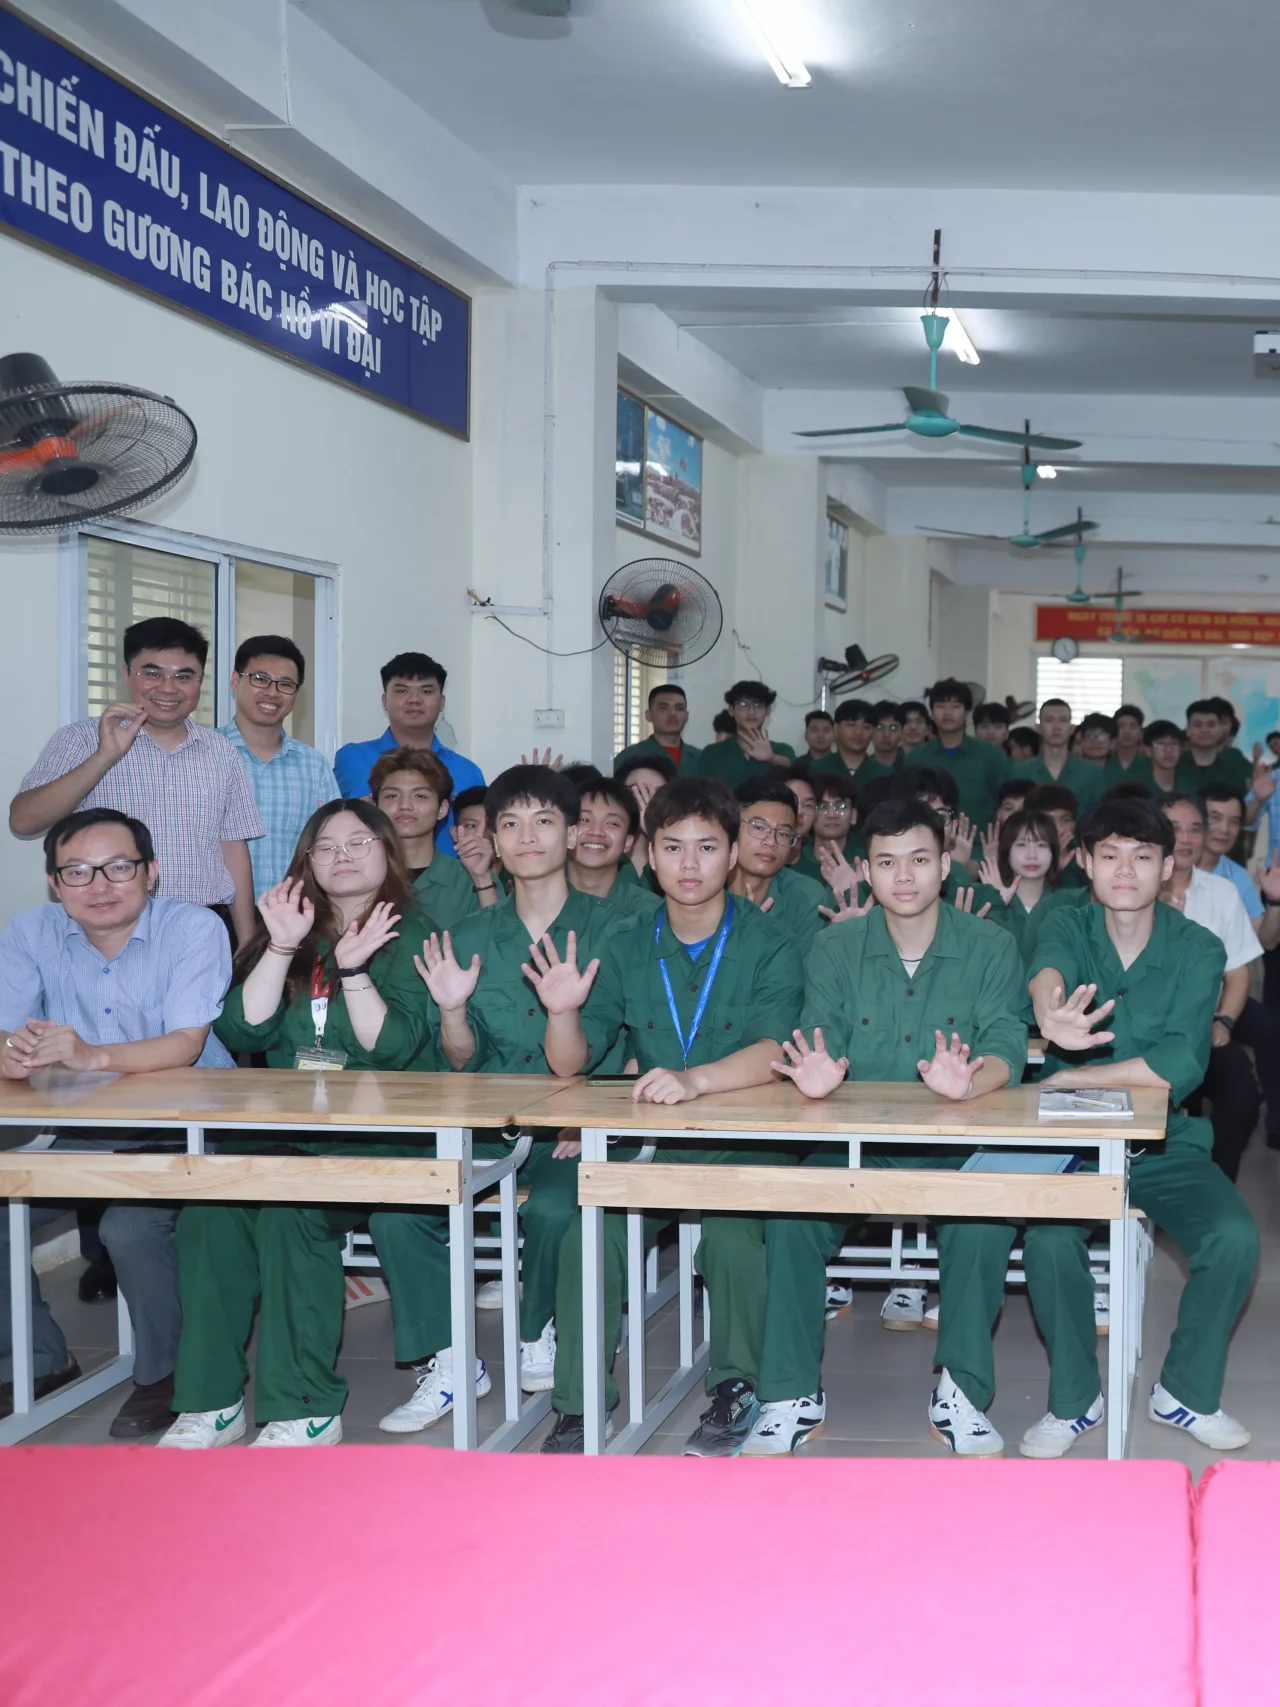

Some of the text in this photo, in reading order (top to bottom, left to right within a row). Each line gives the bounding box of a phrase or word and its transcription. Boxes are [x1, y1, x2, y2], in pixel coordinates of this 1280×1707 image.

[0, 49, 443, 346] CHIẾN ĐẤU, LAO ĐỘNG VÀ HỌC TẬP
[0, 141, 93, 234] THEO
[104, 199, 211, 293] GƯƠNG
[221, 258, 273, 322] BÁC
[280, 285, 312, 340] HỒ
[347, 321, 382, 379] ĐẠI
